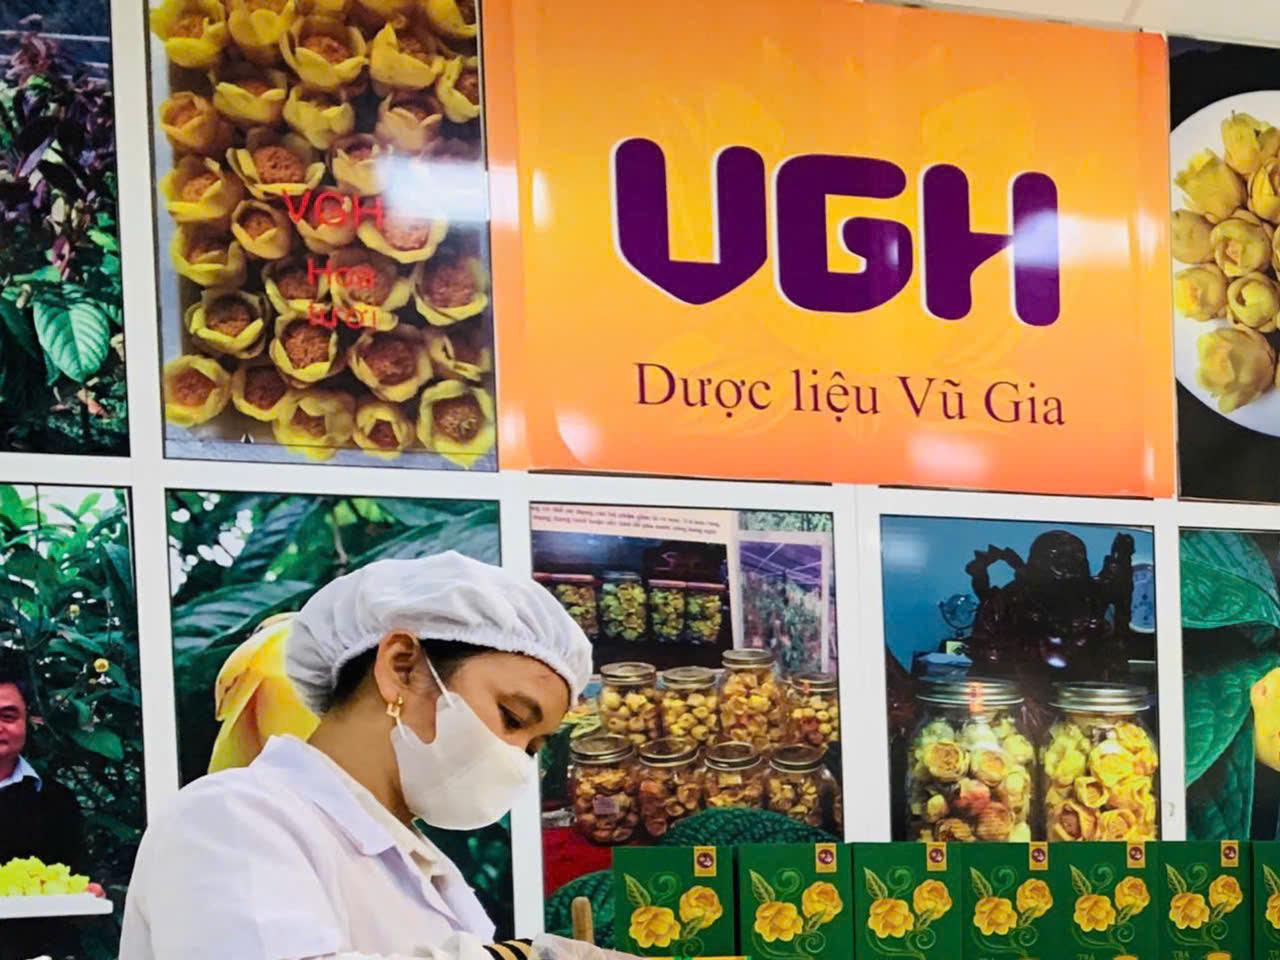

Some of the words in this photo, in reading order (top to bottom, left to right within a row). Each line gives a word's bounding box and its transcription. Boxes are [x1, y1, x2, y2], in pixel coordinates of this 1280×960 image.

[634, 362, 771, 418] Dược
[791, 369, 879, 423] liệu
[896, 375, 966, 419] Vũ
[984, 379, 1065, 425] Gia
